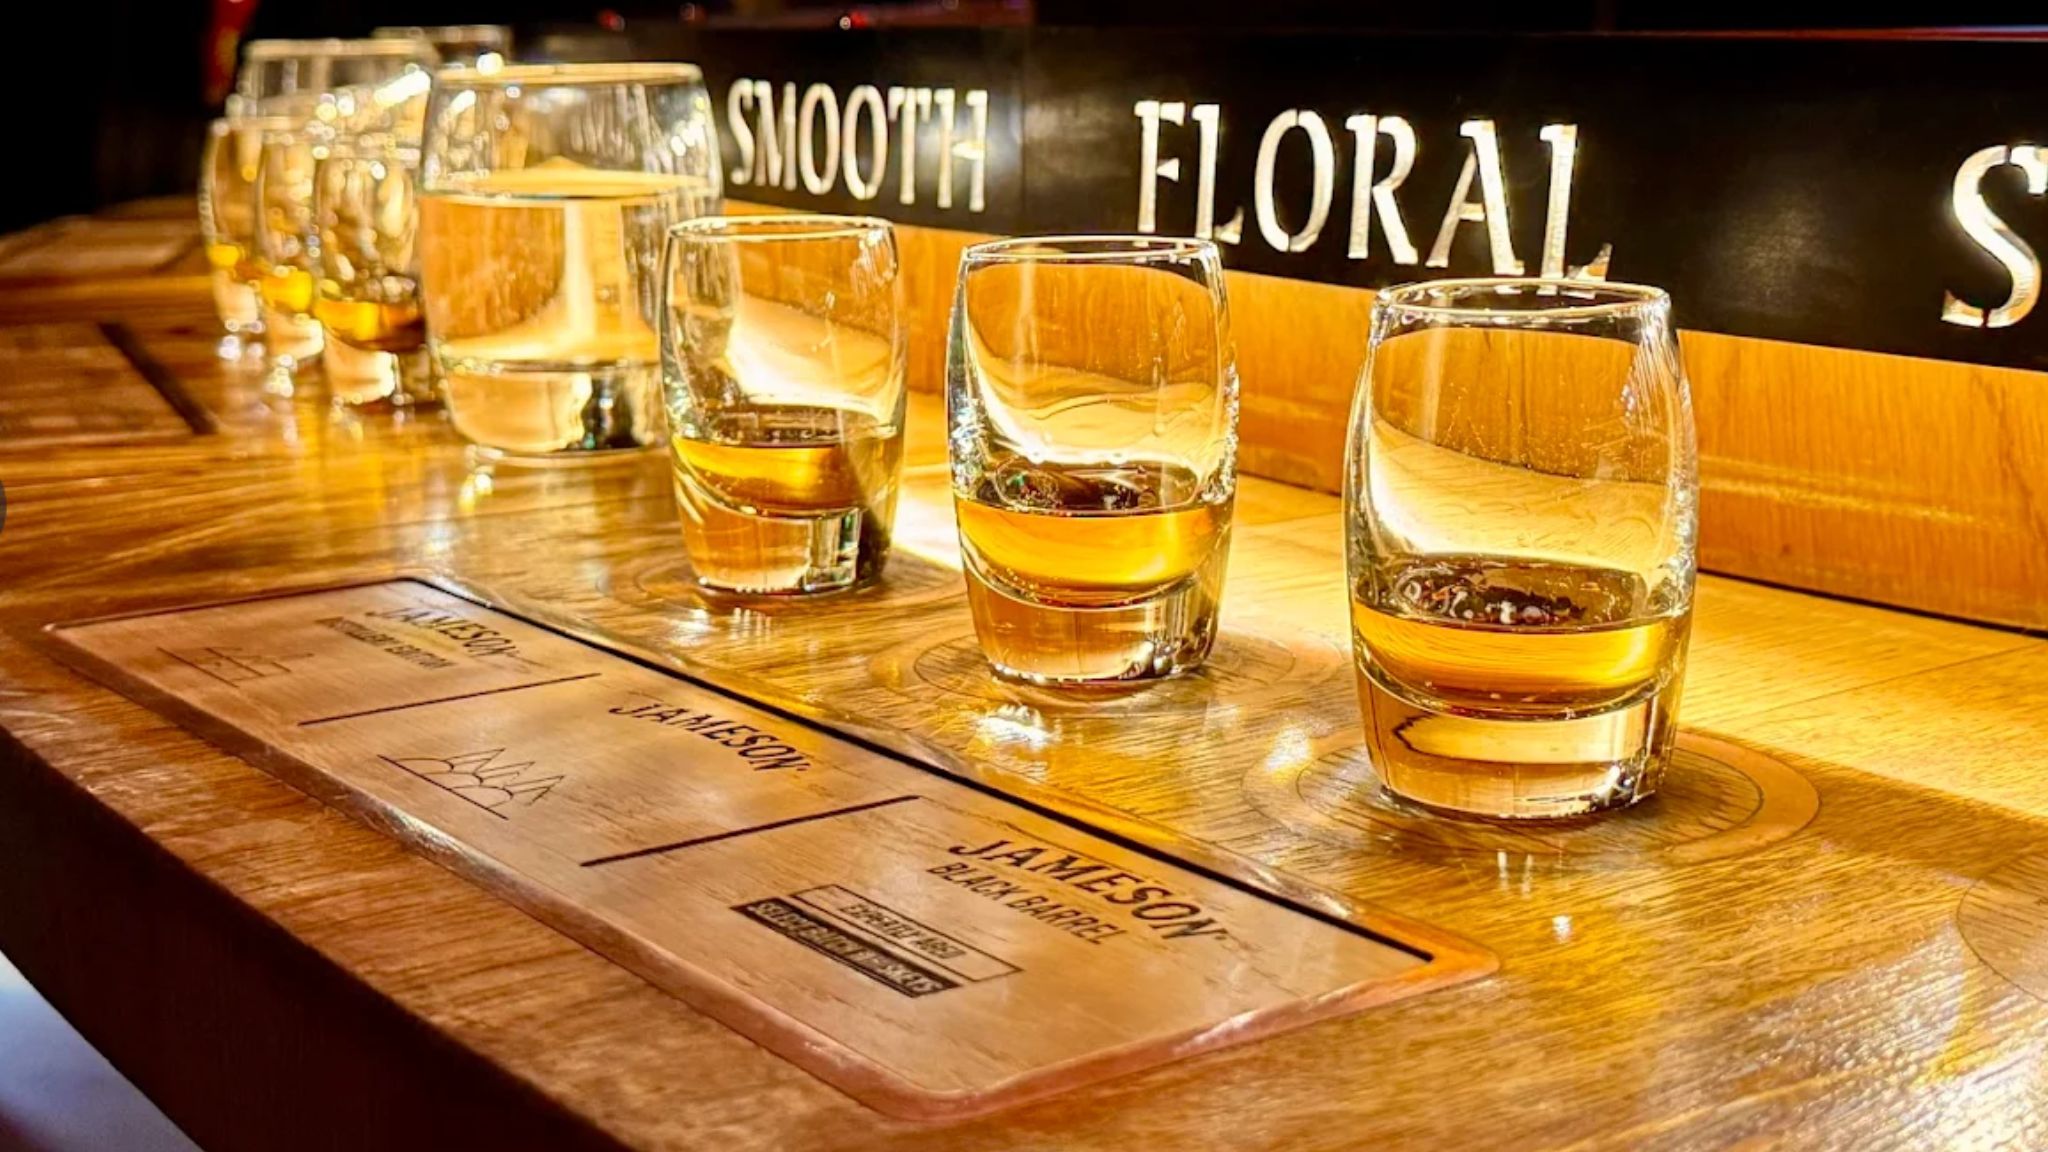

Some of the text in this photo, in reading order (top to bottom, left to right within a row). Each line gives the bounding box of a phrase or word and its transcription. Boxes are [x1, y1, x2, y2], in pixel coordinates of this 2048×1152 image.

[728, 78, 987, 212] SMOOTH
[1134, 101, 1613, 290] FLORAL
[1941, 145, 2048, 328] S
[608, 703, 805, 772] JAMESON
[926, 862, 1127, 945] BLACK BARREL
[947, 840, 1224, 940] JAMESON
